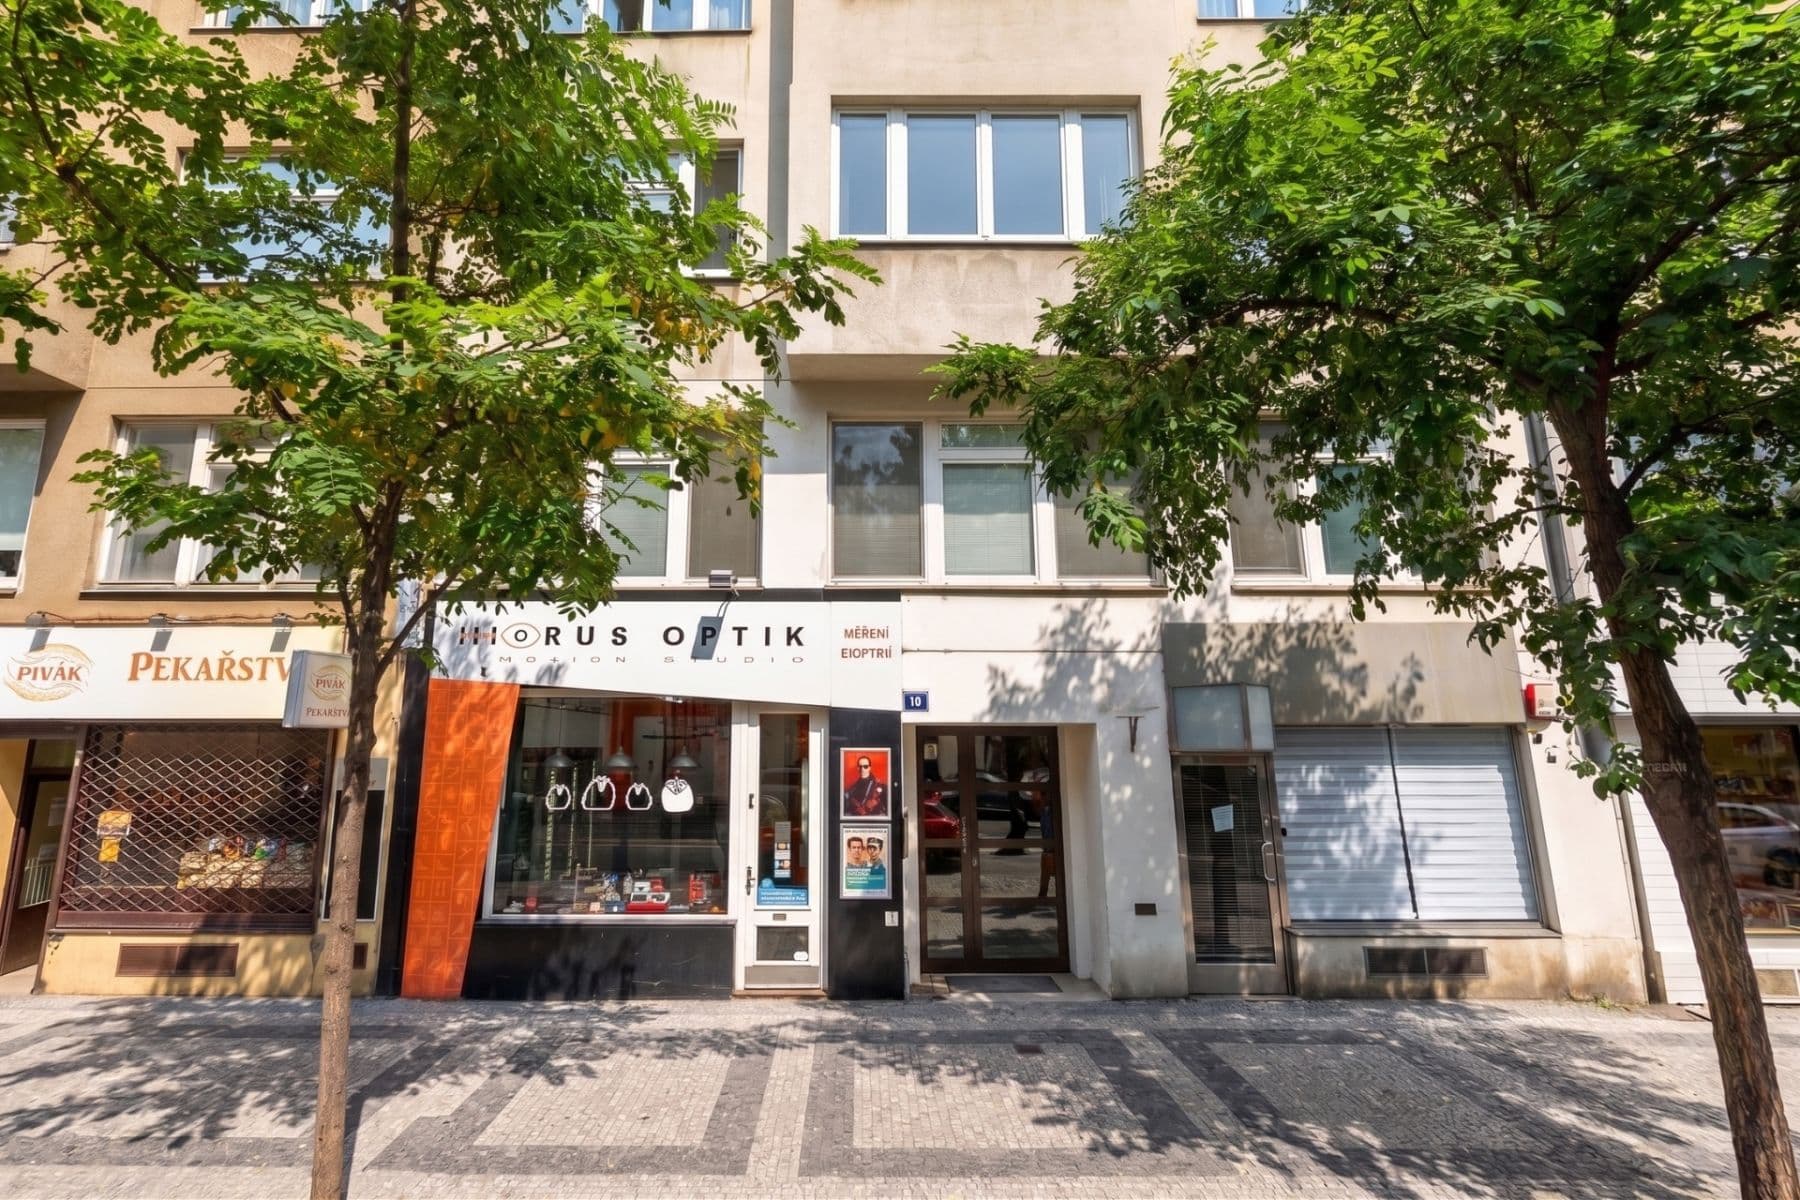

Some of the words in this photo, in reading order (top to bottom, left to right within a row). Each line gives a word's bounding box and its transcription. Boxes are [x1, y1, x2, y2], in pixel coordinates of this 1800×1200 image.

[662, 625, 804, 647] OPTIK
[843, 625, 890, 640] MĚŘENÍ
[16, 661, 83, 682] PIVÁK
[315, 676, 346, 690] PIVÁK
[909, 695, 922, 707] 10
